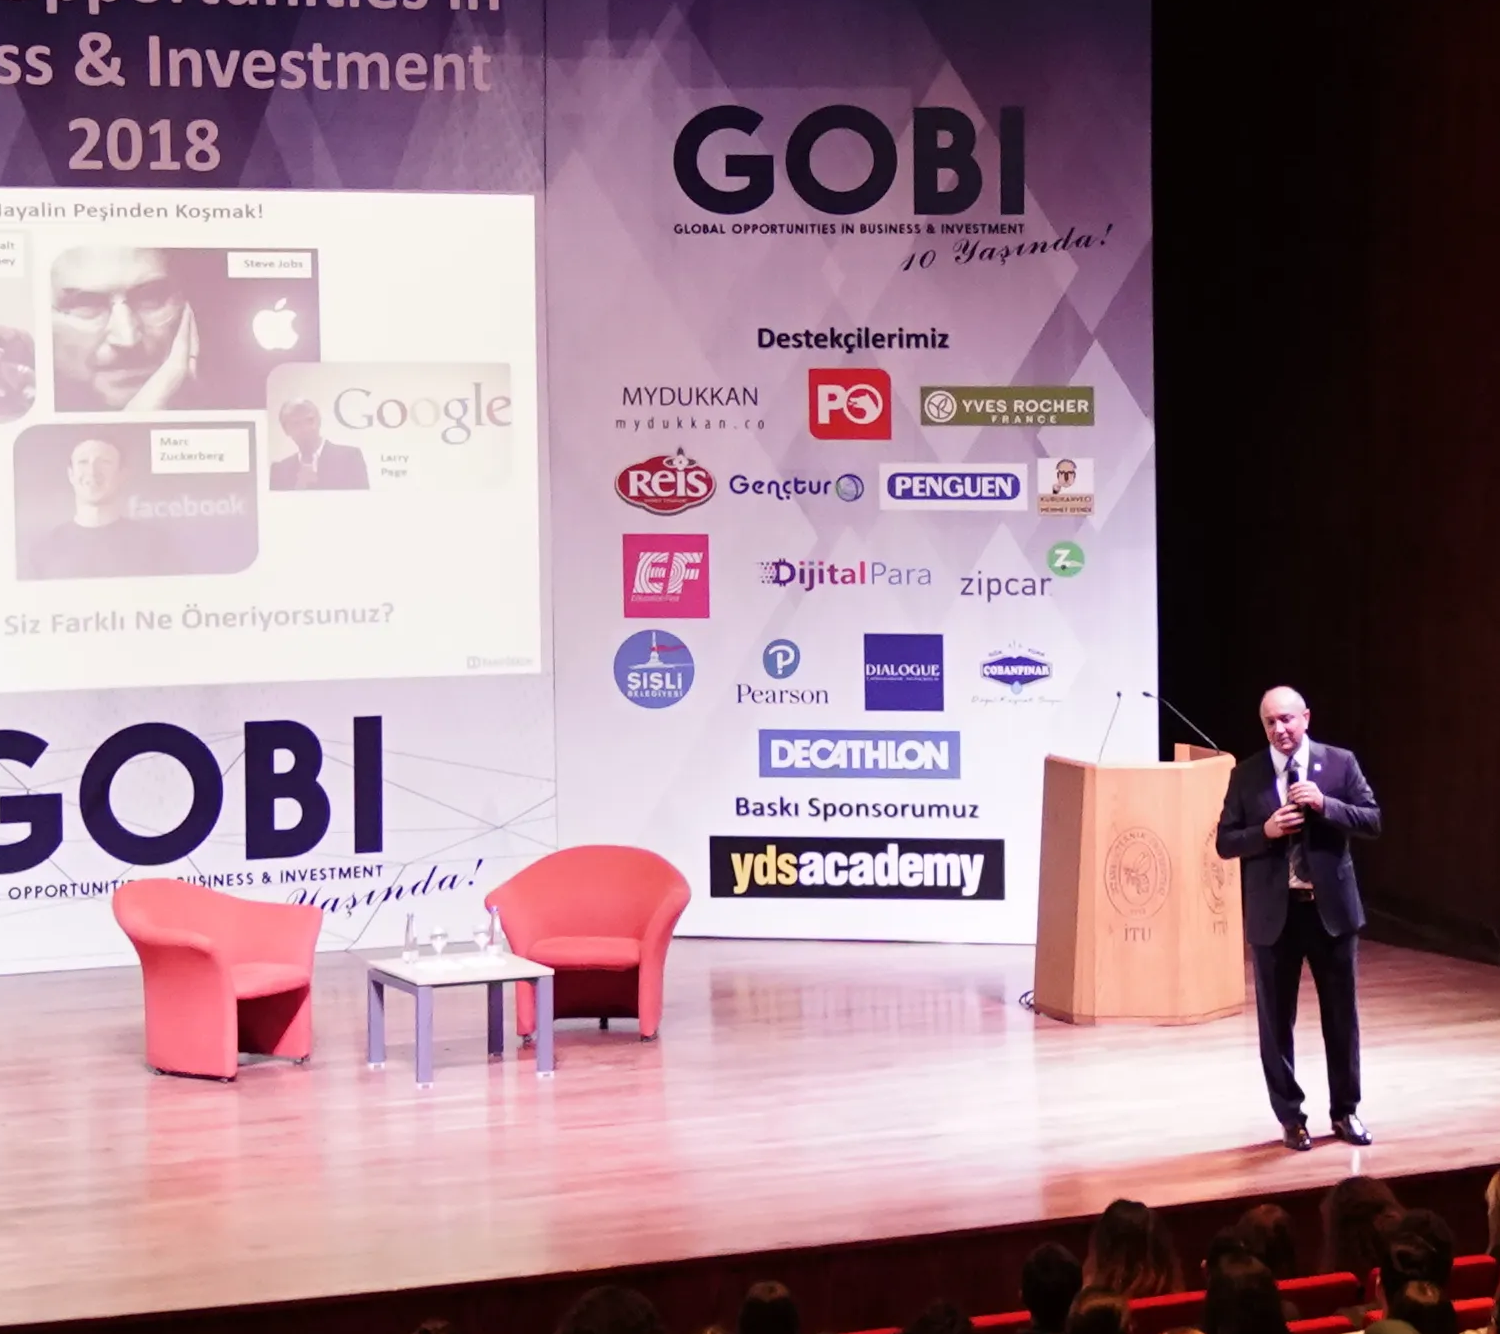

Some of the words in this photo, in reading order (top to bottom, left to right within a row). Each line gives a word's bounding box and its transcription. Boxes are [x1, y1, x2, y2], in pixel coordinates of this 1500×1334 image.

[74, 32, 126, 87] &
[147, 34, 491, 93] Investment
[68, 117, 221, 173] 2018
[673, 104, 1025, 215] GOBI
[73, 203, 169, 222] Peşinden
[175, 203, 264, 223] Koşmak!
[674, 223, 727, 235] GLOBAL
[731, 223, 836, 235] OPPORTUNITIES
[840, 223, 855, 235] IN
[859, 223, 921, 235] BUSINESS
[926, 223, 936, 234] &
[941, 223, 1025, 235] INVESTMENT
[243, 258, 275, 270] Steve
[757, 328, 950, 353] Destekçilerimiz
[622, 387, 759, 407] MYDUKKAN
[962, 399, 1007, 413] YVES
[1014, 399, 1089, 413] ROCHER
[333, 381, 513, 445] Google
[615, 417, 765, 431] mydukkan.co
[991, 415, 1057, 424] FRANCE
[160, 451, 225, 463] Zuckerberg
[729, 474, 832, 499] Gençtur
[895, 476, 1013, 500] PENGUEN
[128, 493, 246, 520] facebook
[632, 552, 704, 594] EF
[960, 571, 1052, 602] zipcar
[4, 614, 41, 637] Siz
[51, 611, 126, 634] Farklı
[136, 610, 172, 630] Ne
[181, 602, 394, 631] Öneriyorsunuz?
[866, 663, 940, 676] DIALOGUE
[736, 683, 829, 705] Pearson
[770, 739, 949, 770] DECATHLON
[735, 796, 800, 817] Baskı
[808, 797, 980, 821] Sponsorumuz
[261, 870, 273, 884] &
[280, 864, 383, 883] INVESTMENT
[730, 844, 985, 896] ydsacademy
